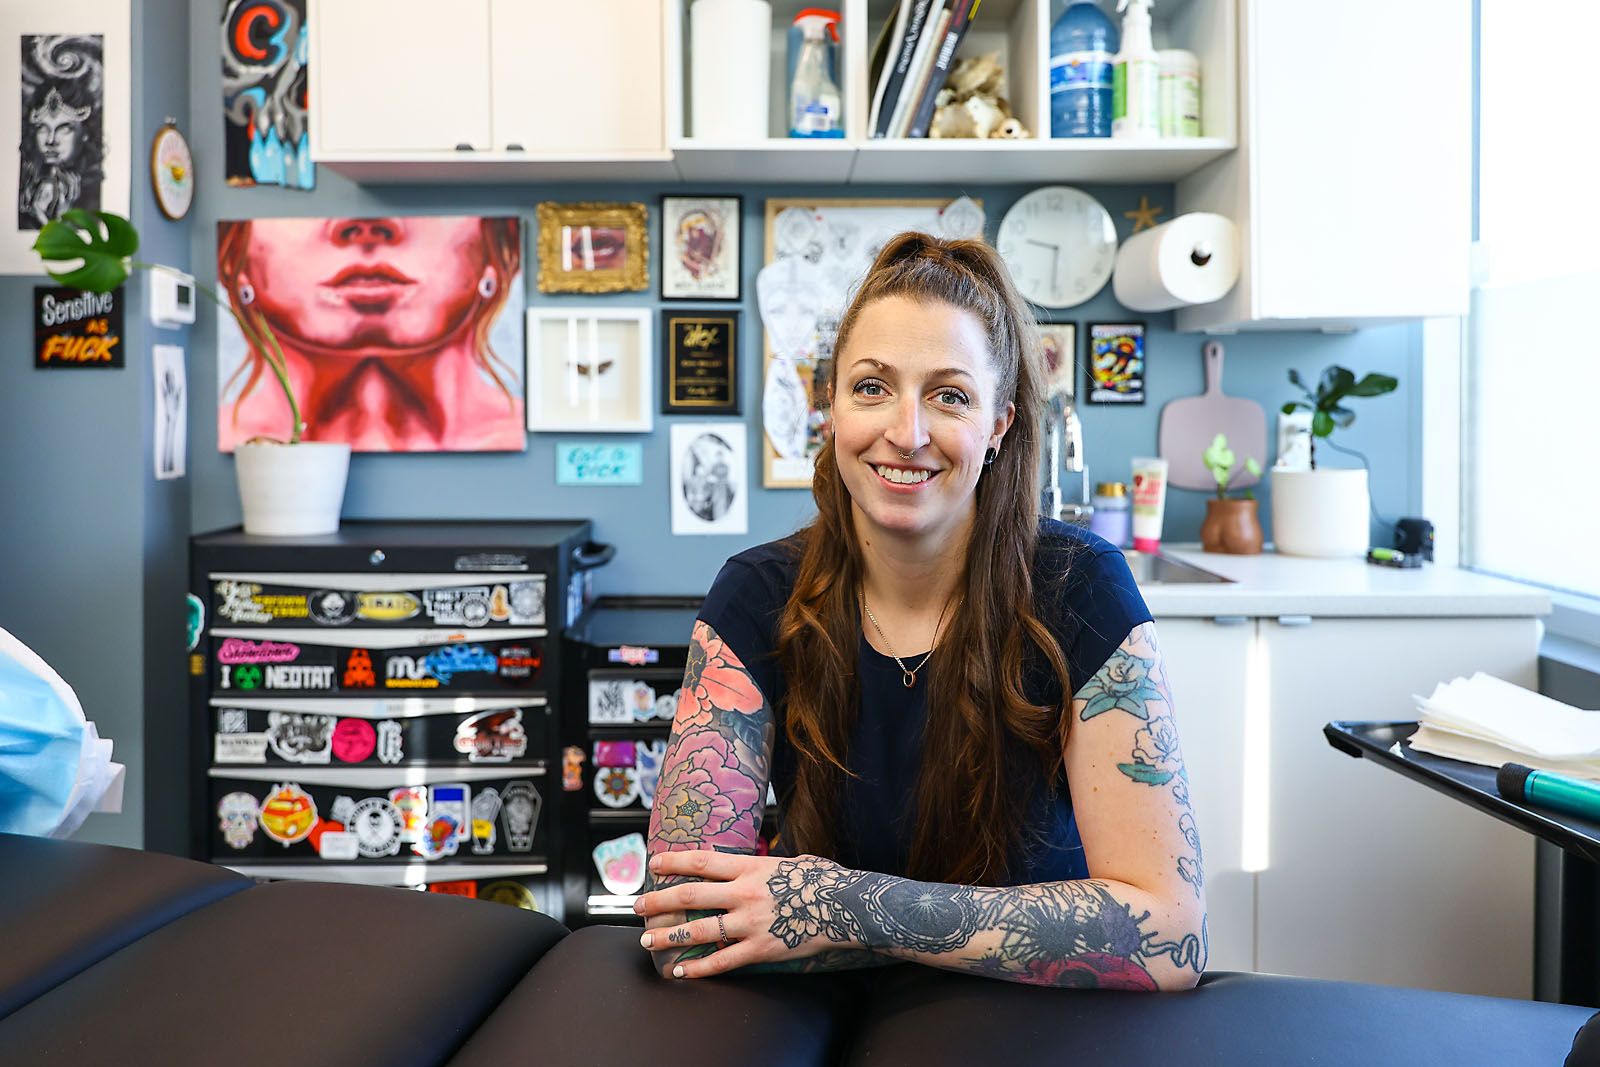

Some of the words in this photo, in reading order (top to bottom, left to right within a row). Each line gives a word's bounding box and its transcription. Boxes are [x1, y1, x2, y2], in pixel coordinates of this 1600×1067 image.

[42, 290, 113, 327] Sensitive
[86, 318, 108, 335] AS
[41, 334, 119, 362] FUCK
[265, 665, 335, 689] NEOTAT
